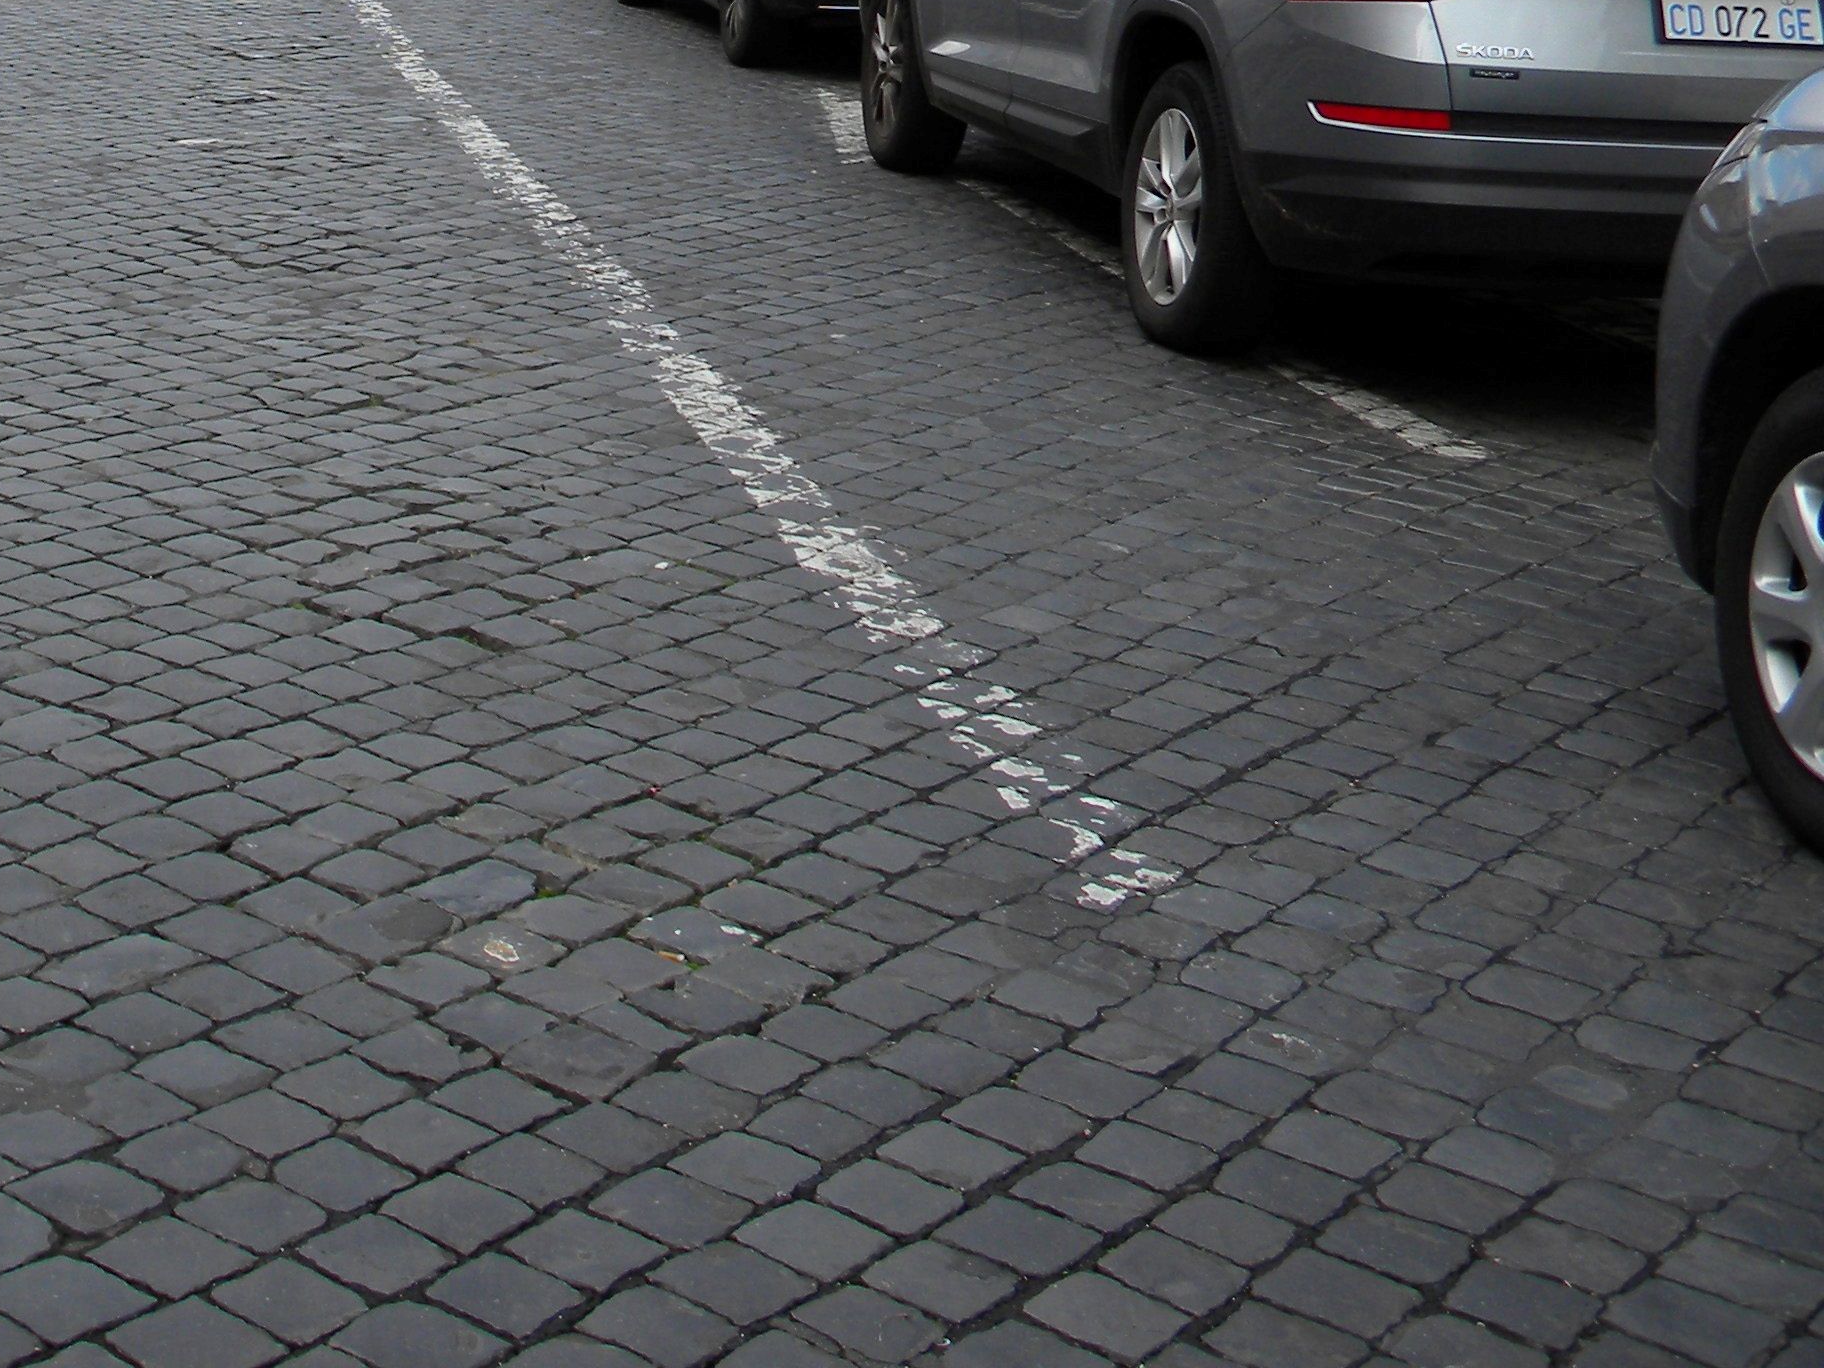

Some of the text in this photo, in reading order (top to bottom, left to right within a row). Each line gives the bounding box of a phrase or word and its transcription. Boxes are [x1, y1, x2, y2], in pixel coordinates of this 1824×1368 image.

[1669, 3, 1814, 41] CD 072 GE
